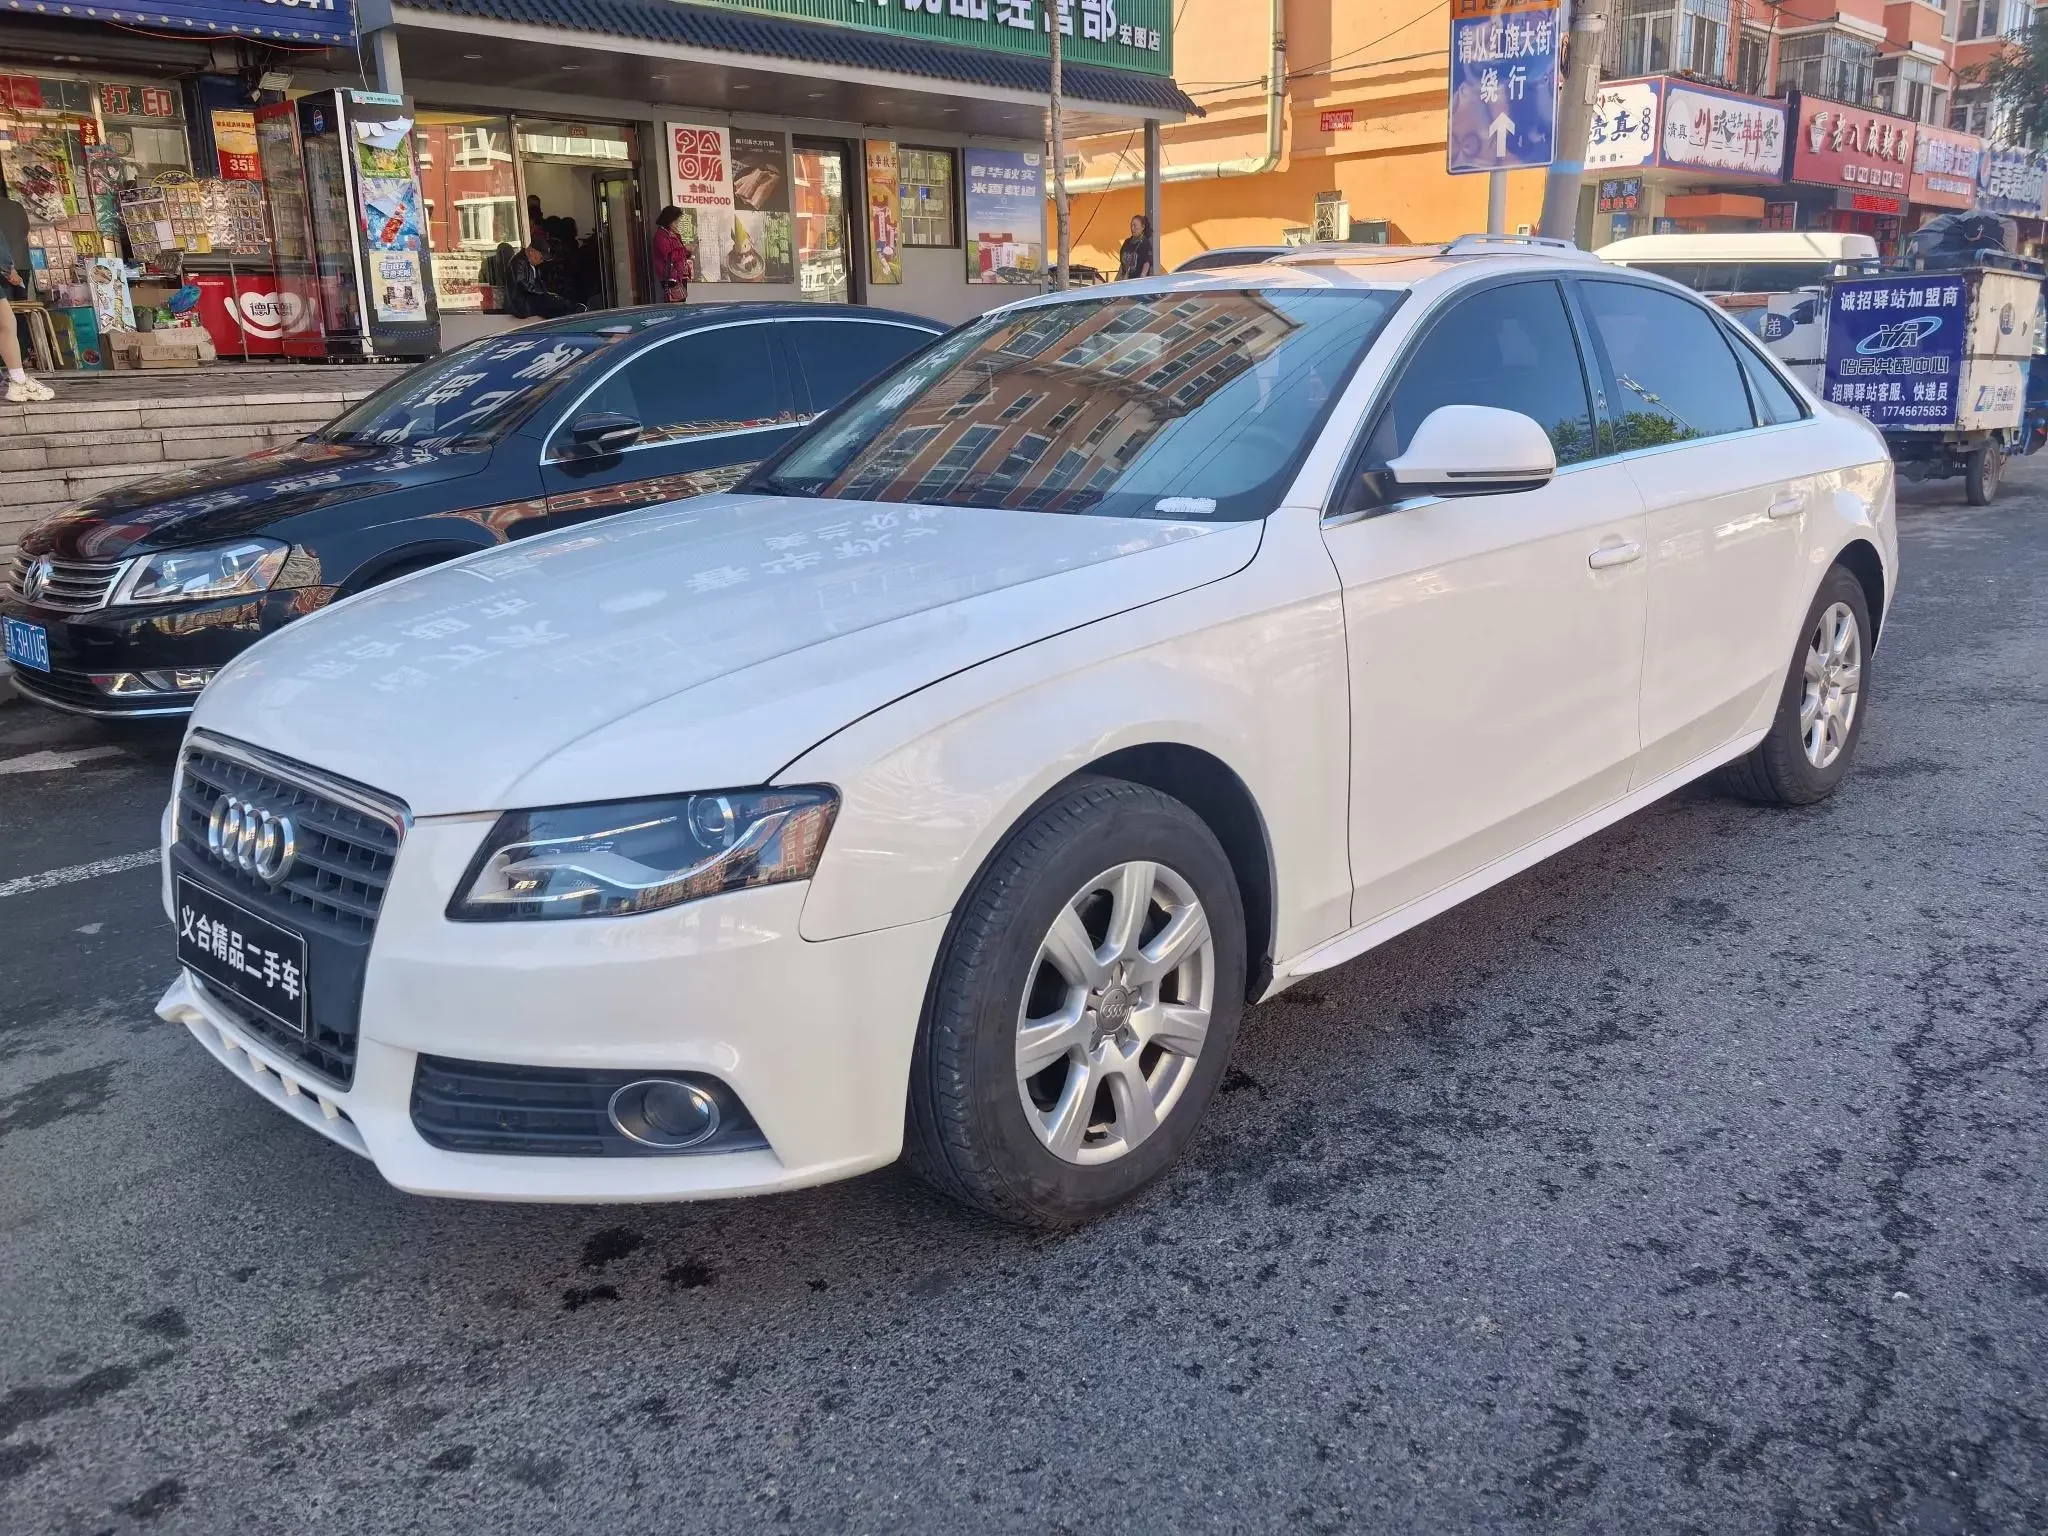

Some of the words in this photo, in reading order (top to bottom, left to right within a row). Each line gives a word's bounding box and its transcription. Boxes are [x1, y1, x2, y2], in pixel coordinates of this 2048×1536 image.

[1120, 23, 1160, 51] 宏图店
[1459, 21, 1552, 64] 请从红旗大街
[1481, 65, 1527, 104] 绕行
[101, 83, 173, 117] 打印
[1668, 121, 1688, 139] 清真
[676, 194, 731, 206] TEZHENFOOD
[688, 183, 715, 194] 金佛山
[1841, 286, 1959, 311] 诚招驿站加盟商
[1913, 381, 1949, 401] 快递员
[1882, 405, 1948, 417] 17745675853
[181, 905, 300, 1000] 义合精品二手车
